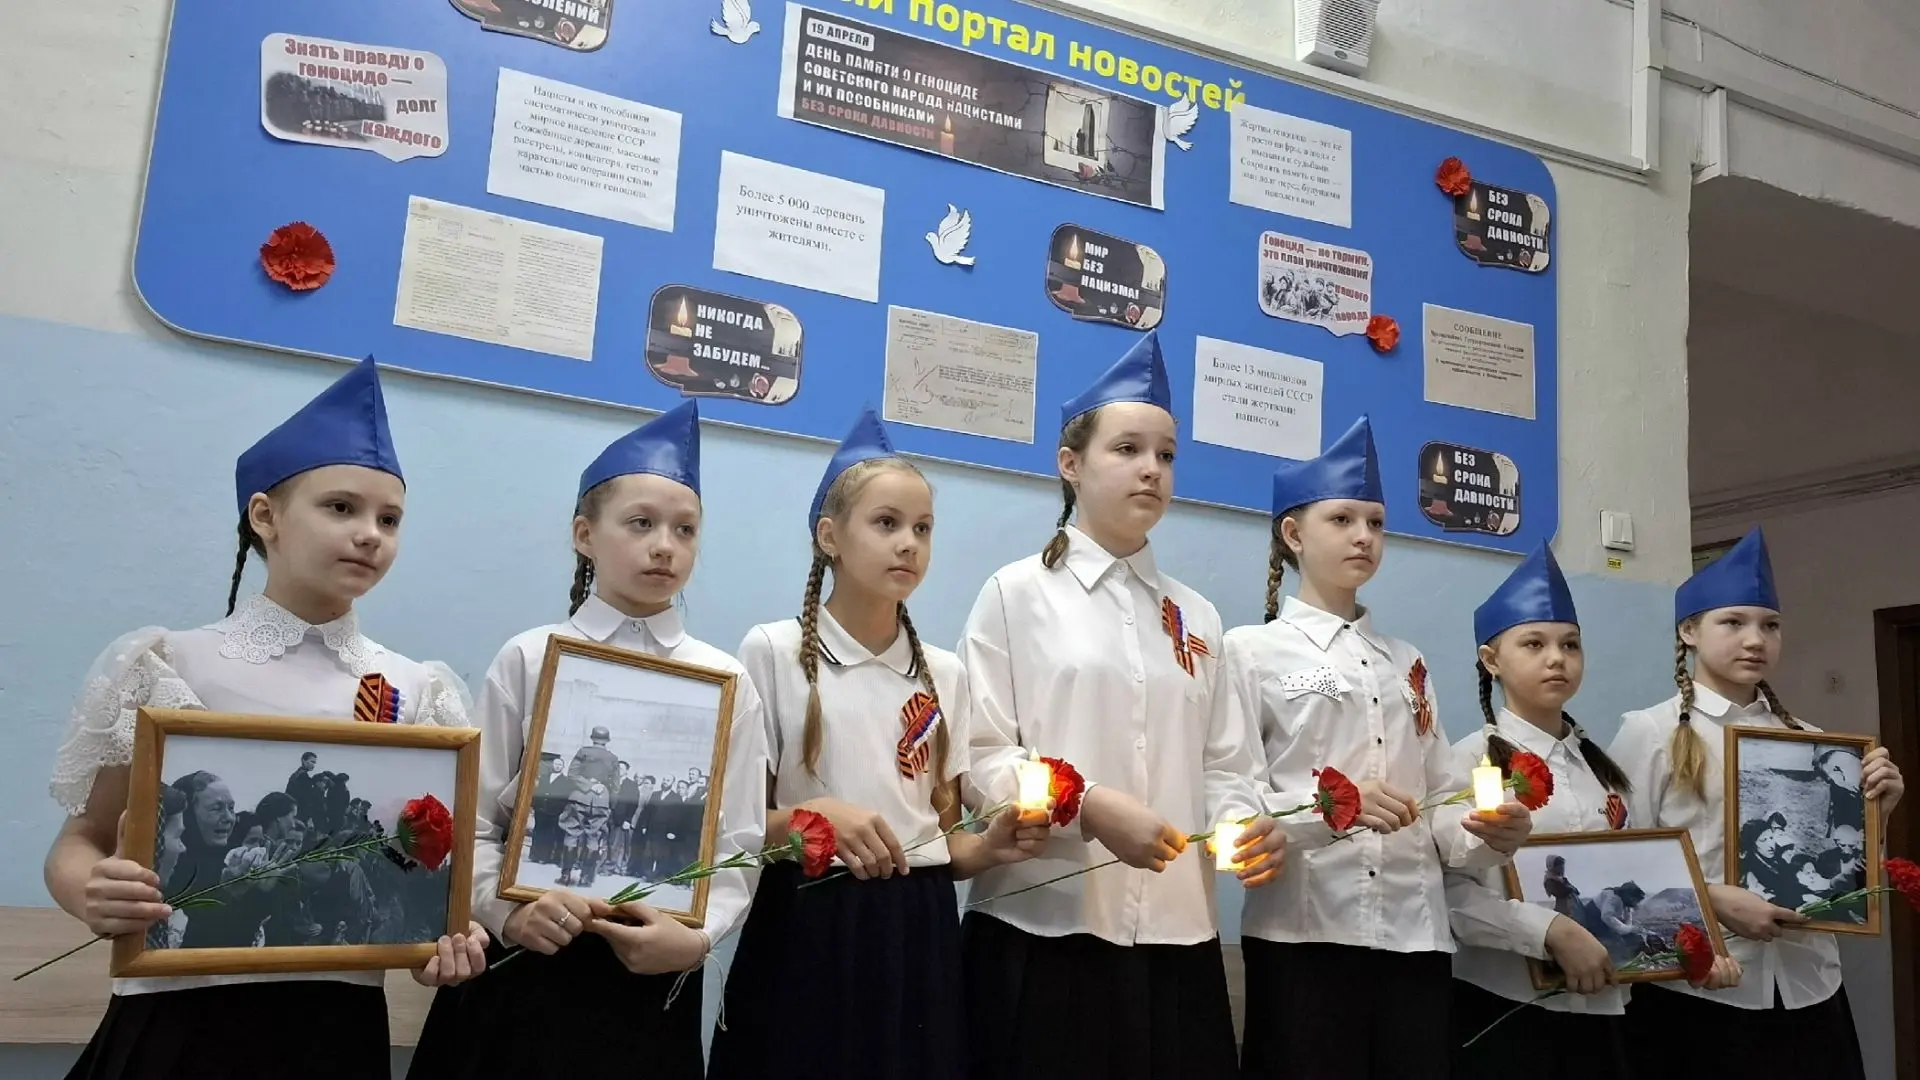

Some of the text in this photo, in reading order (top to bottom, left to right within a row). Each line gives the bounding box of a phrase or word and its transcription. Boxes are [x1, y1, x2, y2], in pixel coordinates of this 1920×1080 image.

[811, 22, 871, 47] 19 АПРЕЛЯ
[285, 38, 424, 71] Знать правду о
[908, 0, 1246, 112] портал новостей
[299, 62, 388, 86] геноциде
[805, 43, 979, 101] ДЕНЬ ПАМЯТИ О ГЕНОЦИДЕ
[396, 99, 437, 115] долг
[533, 85, 576, 104] Нацисты
[587, 101, 598, 111] их
[600, 104, 650, 123] пособники
[802, 79, 935, 124] И ИХ ПОСОБНИКАМИ
[804, 61, 1023, 130] СОВЕТСКОГО НАРОДА НАЦИСТАМИ
[524, 98, 656, 137] систематически уничтожали
[530, 113, 565, 128] мирное
[568, 122, 615, 140] население
[801, 97, 935, 140] БЕЗ СРОКА ДАВНОСТИ
[362, 120, 442, 149] каждого
[617, 147, 661, 164] массовые
[626, 162, 650, 174] гетто
[518, 149, 653, 188] карательные операции стали
[519, 163, 554, 177] частью
[556, 171, 600, 188] политики
[738, 184, 865, 225] Более 5 000 деревень
[1488, 189, 1509, 206] БЕЗ
[736, 204, 865, 242] уничтожены вместе с
[1487, 208, 1523, 227] СРОКА
[768, 229, 832, 252] жителями.
[1084, 241, 1109, 259] МИР
[1487, 225, 1544, 250] ДАВНОСТИ
[1264, 234, 1305, 254] Геноцид
[1318, 247, 1330, 258] не
[1332, 250, 1369, 267] термин,
[1082, 258, 1104, 274] БЕЗ
[1263, 249, 1369, 280] это план уничтожения
[1081, 274, 1140, 300] НАЦИЗМА!
[1335, 284, 1369, 303] нашего
[697, 304, 764, 331] НИКОГДА
[1335, 311, 1369, 322] народа
[695, 323, 713, 340] НЕ
[1212, 357, 1307, 387] Более 13 миллионов
[1204, 374, 1313, 402] мирных жителей СССР
[1222, 393, 1296, 415] стали жертвами
[1454, 451, 1476, 467] БЕЗ
[1454, 469, 1491, 488] СРОКА
[1454, 488, 1514, 511] ДАВНОСТИ
